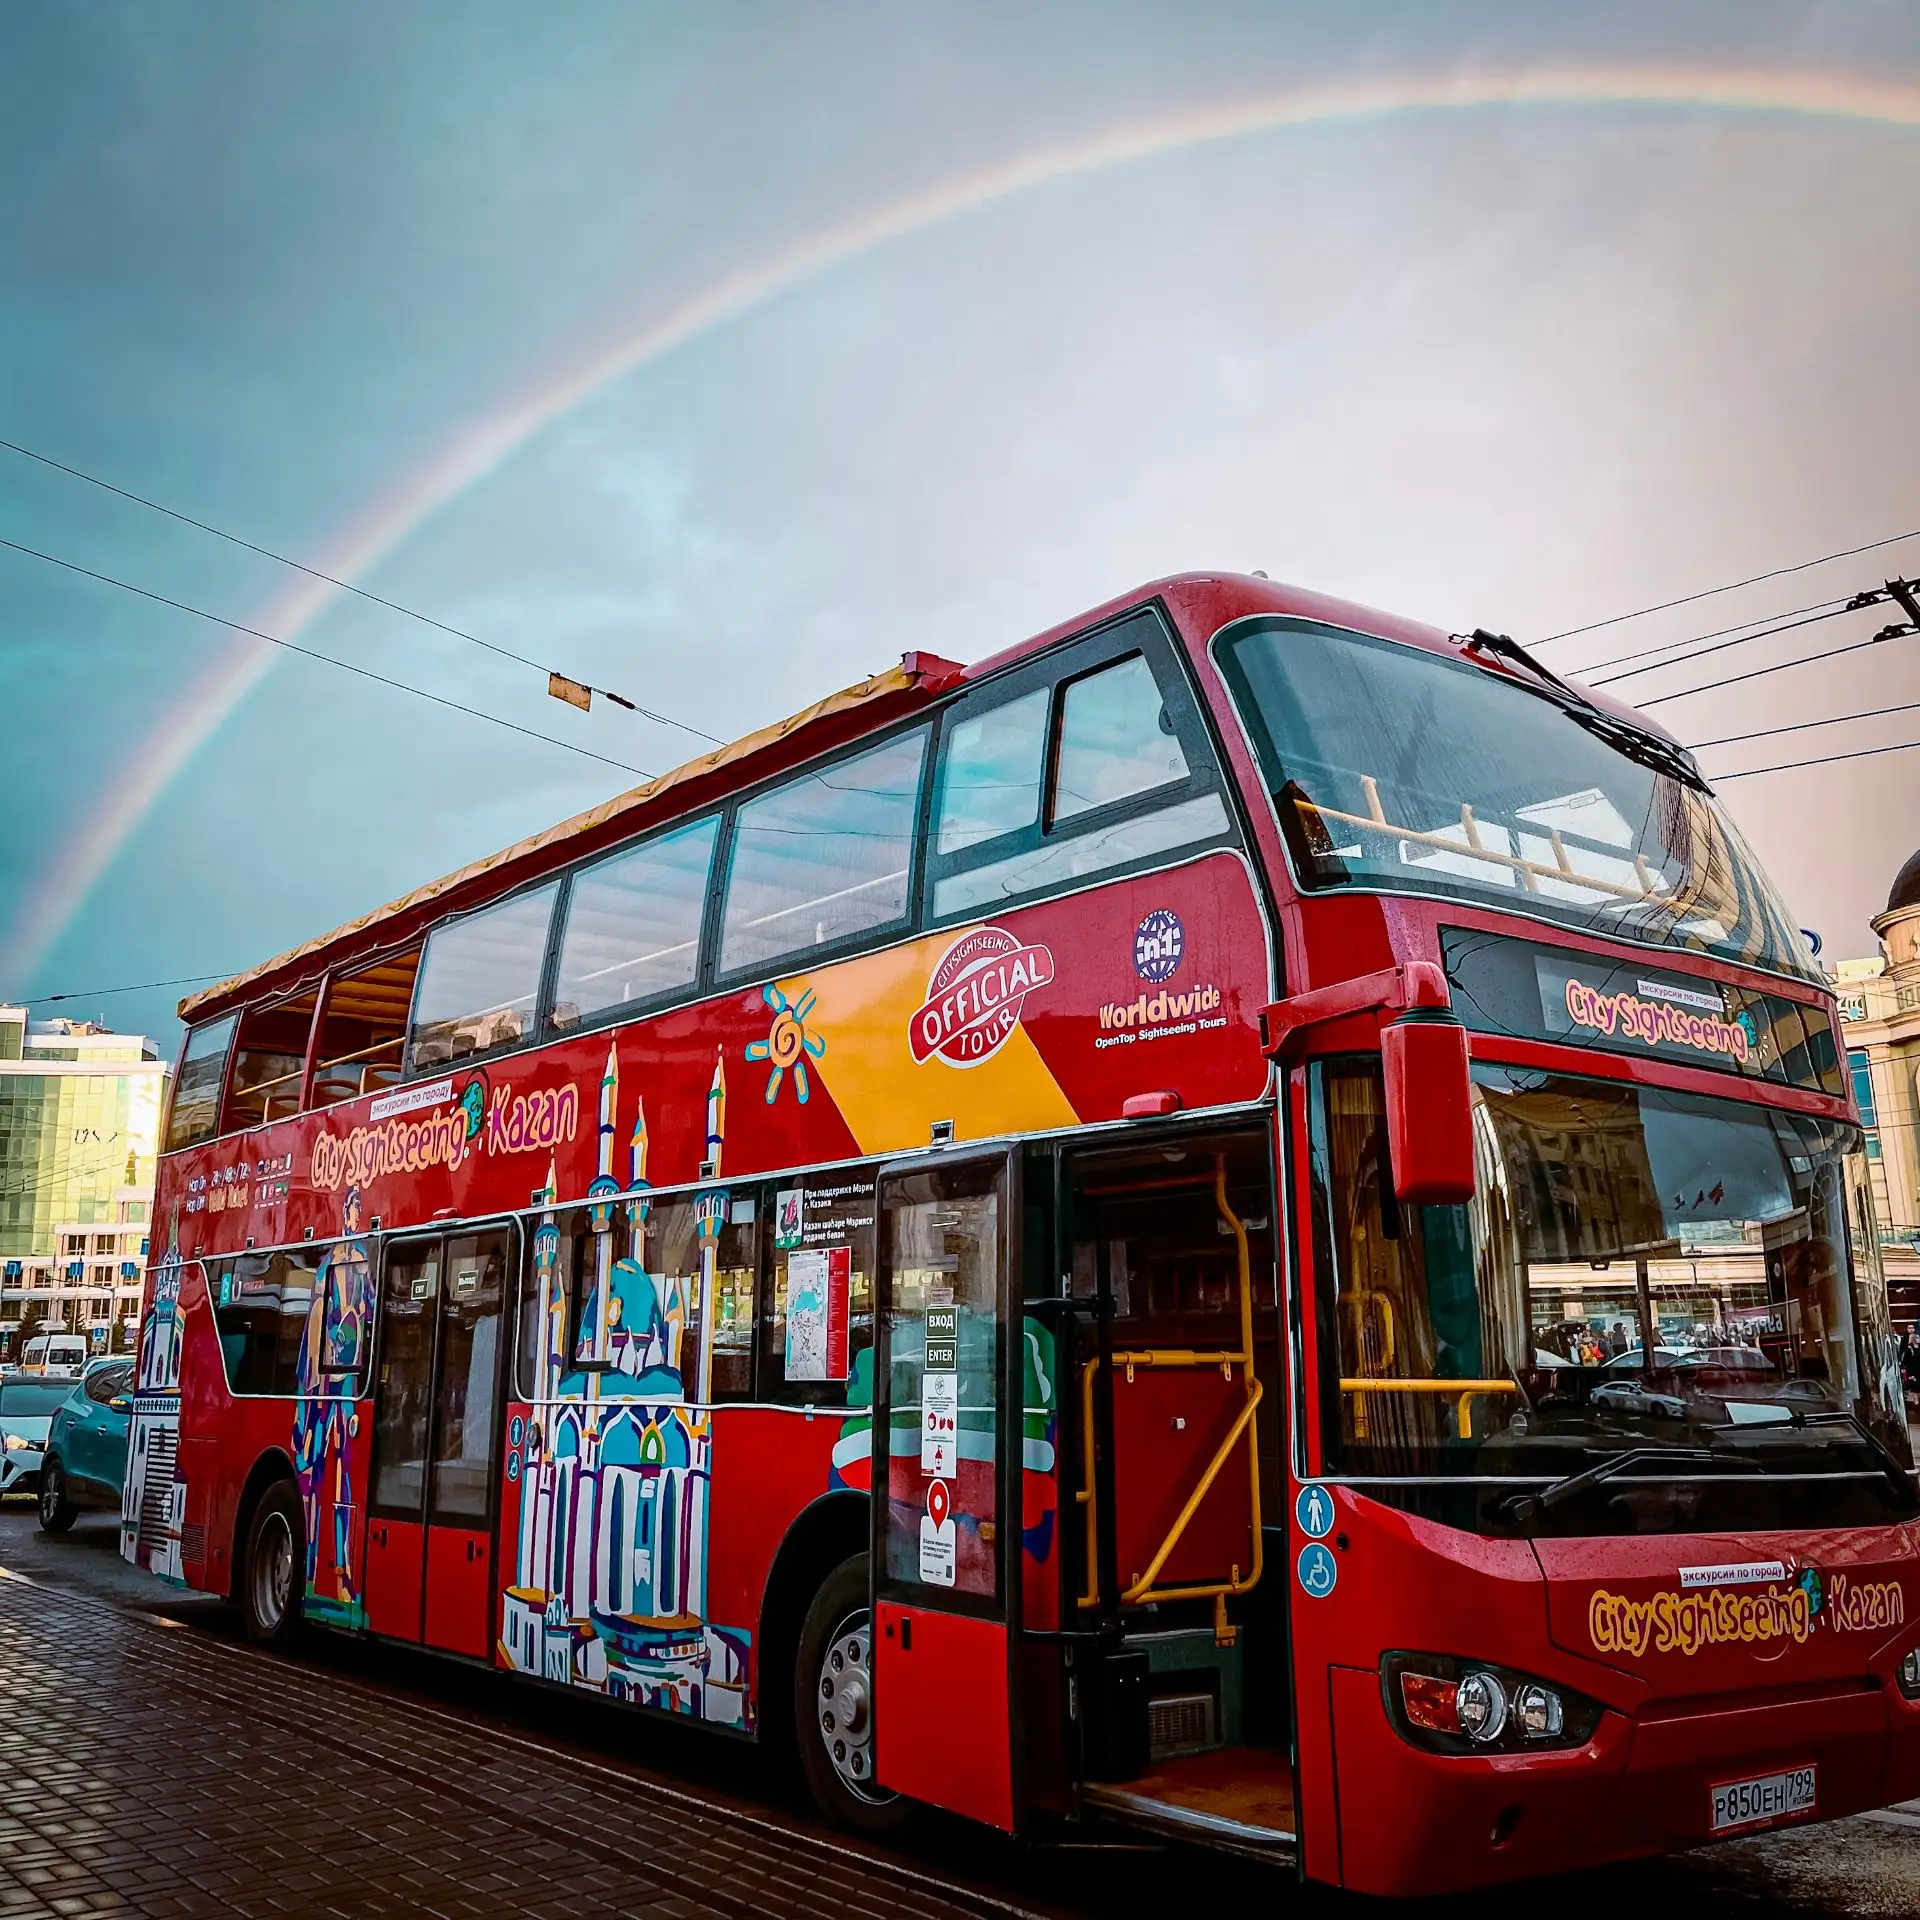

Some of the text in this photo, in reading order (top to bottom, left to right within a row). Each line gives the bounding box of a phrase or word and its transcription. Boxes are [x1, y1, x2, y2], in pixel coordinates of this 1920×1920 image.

[937, 936, 1010, 988] CITYSIGHTSEEING
[922, 952, 1045, 1046] OFFICIAL
[1099, 984, 1221, 1029] Worldwide
[1639, 983, 1722, 1010] экскурсии по городу
[960, 1007, 1015, 1055] TOUR
[1138, 1022, 1196, 1041] Sightseeing
[1198, 1016, 1227, 1030] Tours
[371, 1083, 450, 1115] экскурсии по городу
[488, 1082, 579, 1157] Kazan
[928, 1314, 954, 1330] ВХОД
[928, 1349, 953, 1362] ENTER
[1682, 1565, 1783, 1584] экскурсии по городу
[1831, 1574, 1905, 1632] Kazan
[1715, 1770, 1812, 1825] P850EH 799
